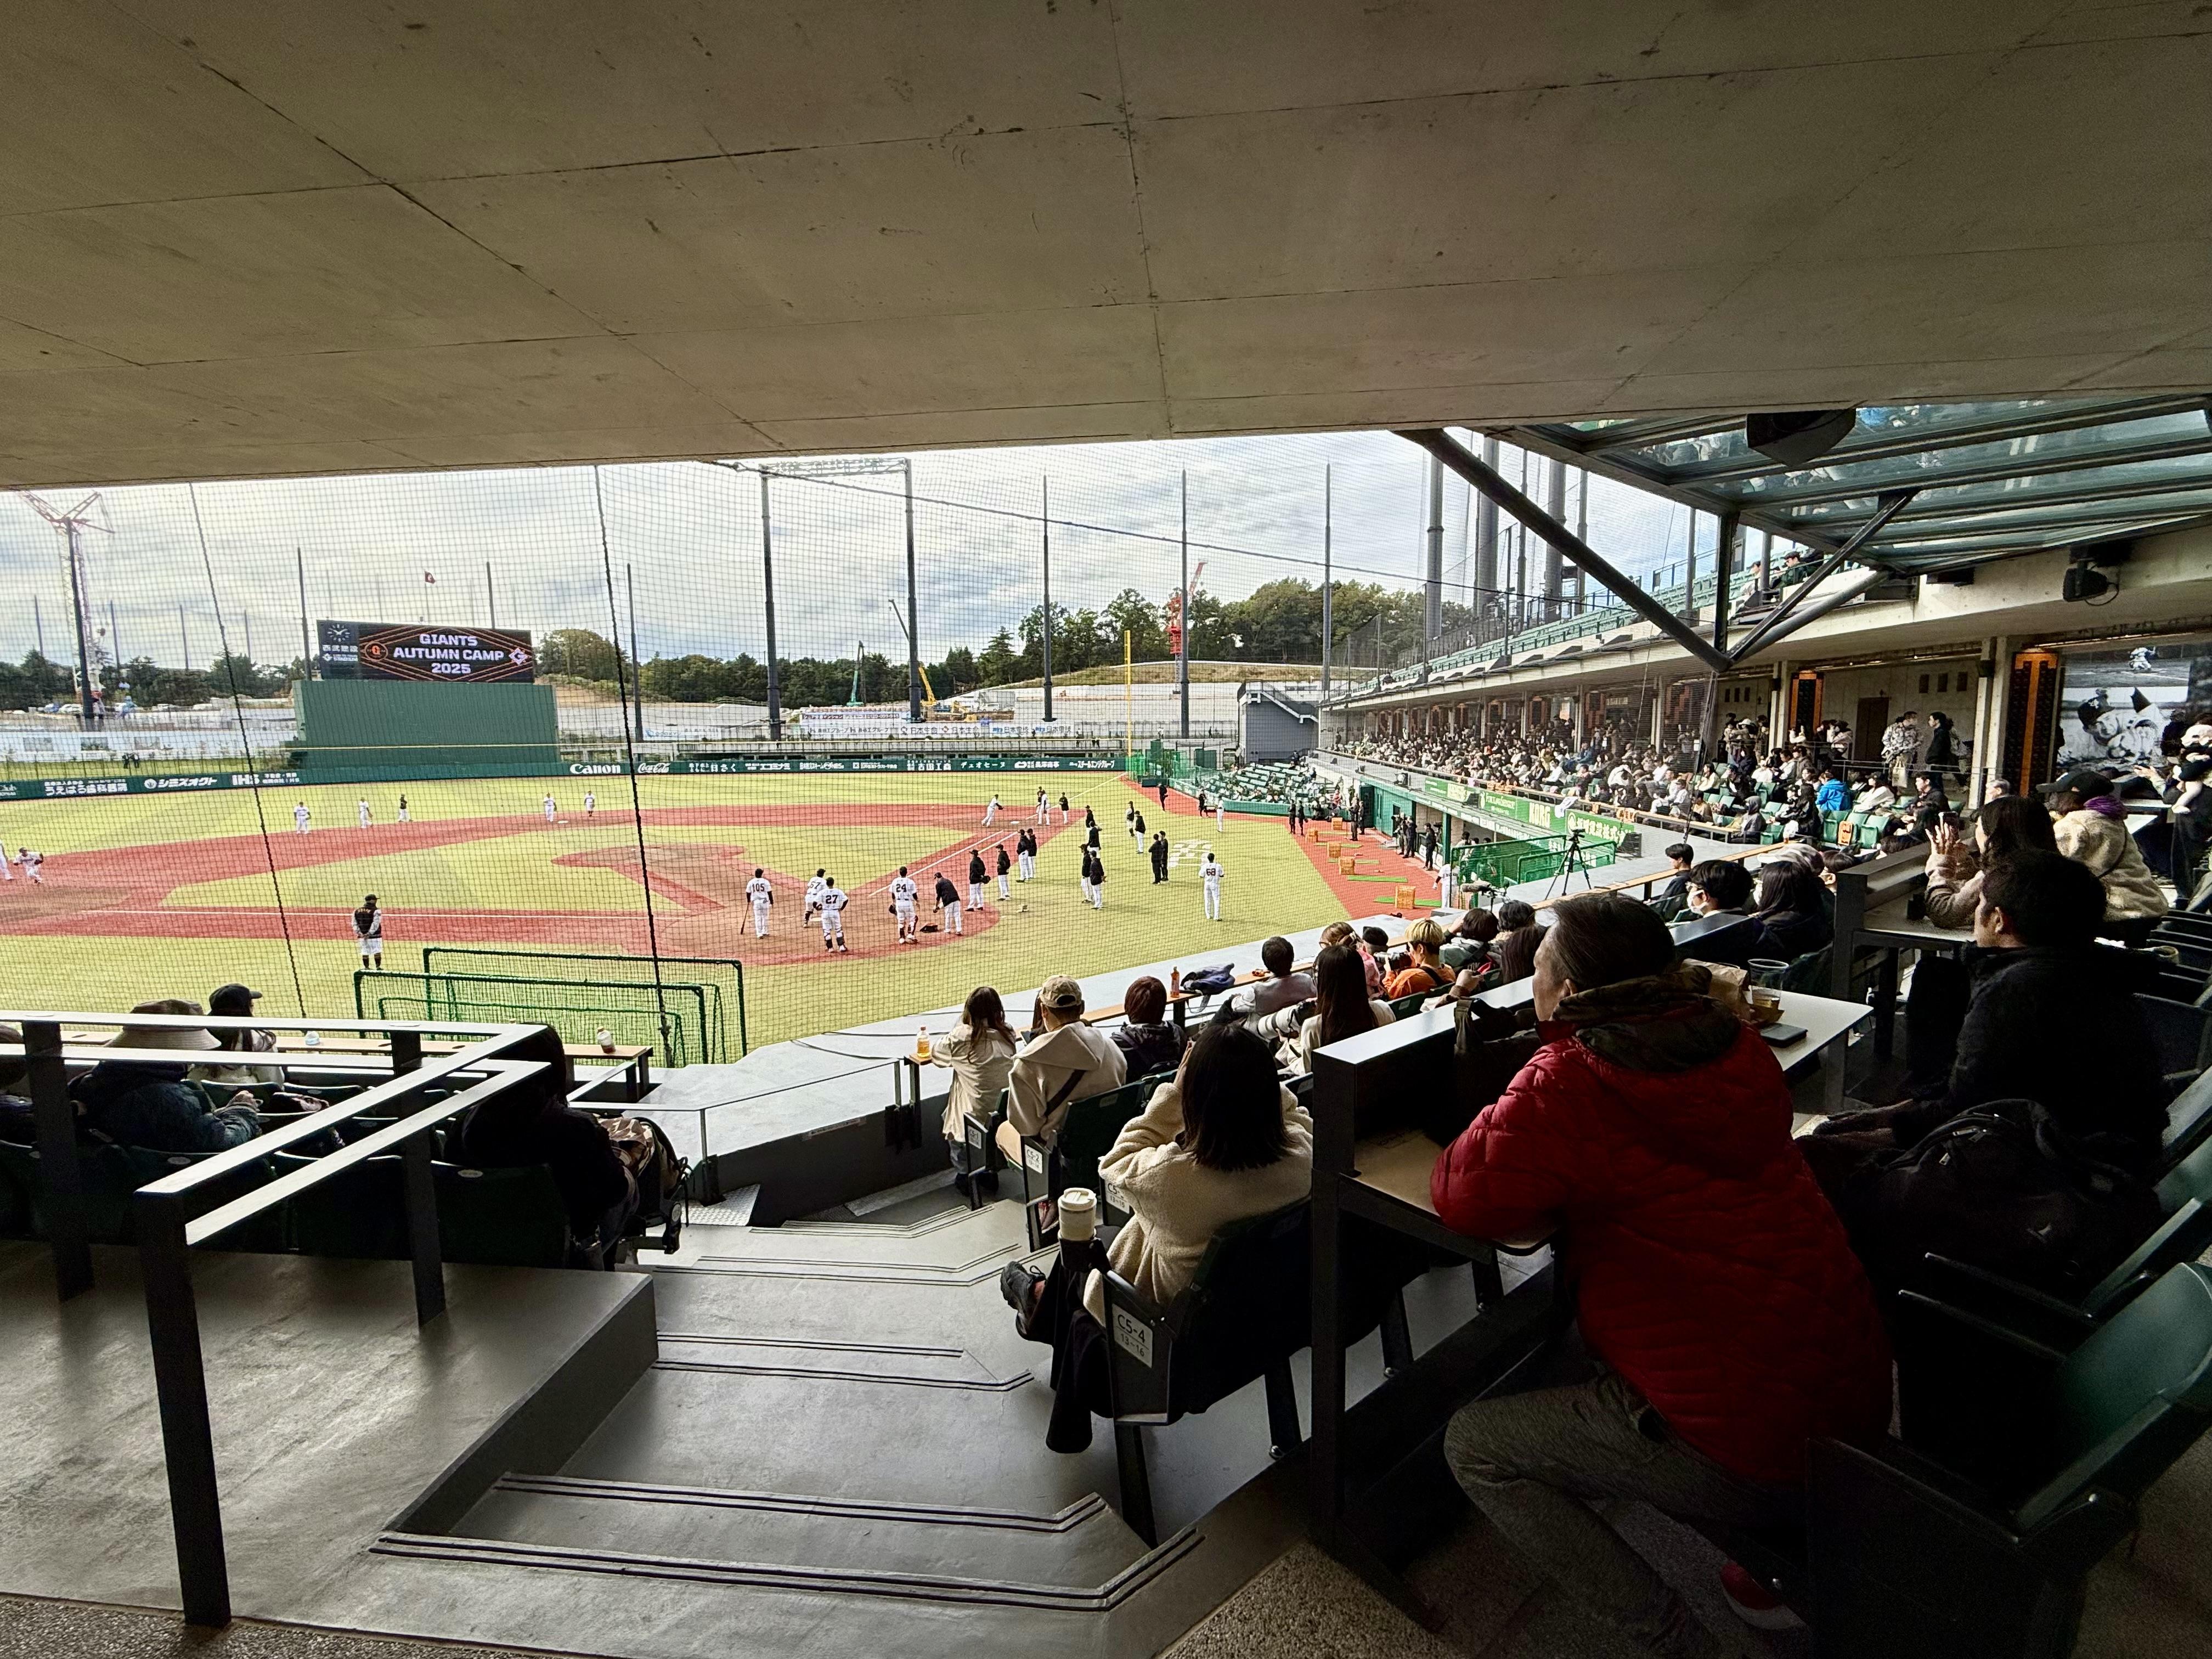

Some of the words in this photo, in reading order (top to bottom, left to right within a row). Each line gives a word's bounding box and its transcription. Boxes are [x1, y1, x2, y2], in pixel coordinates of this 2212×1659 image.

[419, 634, 478, 647] GIANTS
[393, 647, 460, 659] AUTUMN
[462, 650, 504, 661] CAMP
[431, 662, 471, 674] 2025
[570, 764, 621, 774] Canon
[158, 777, 217, 787] シミズオクト
[232, 775, 259, 786] IHS
[1529, 802, 1550, 828] KORG
[1206, 868, 1216, 876] 68
[752, 883, 765, 892] 105
[896, 884, 907, 893] 24
[825, 895, 838, 904] 27
[1026, 1149, 1040, 1162] C5-2
[1108, 1183, 1124, 1199] C5-
[1118, 1314, 1146, 1343] C5-4
